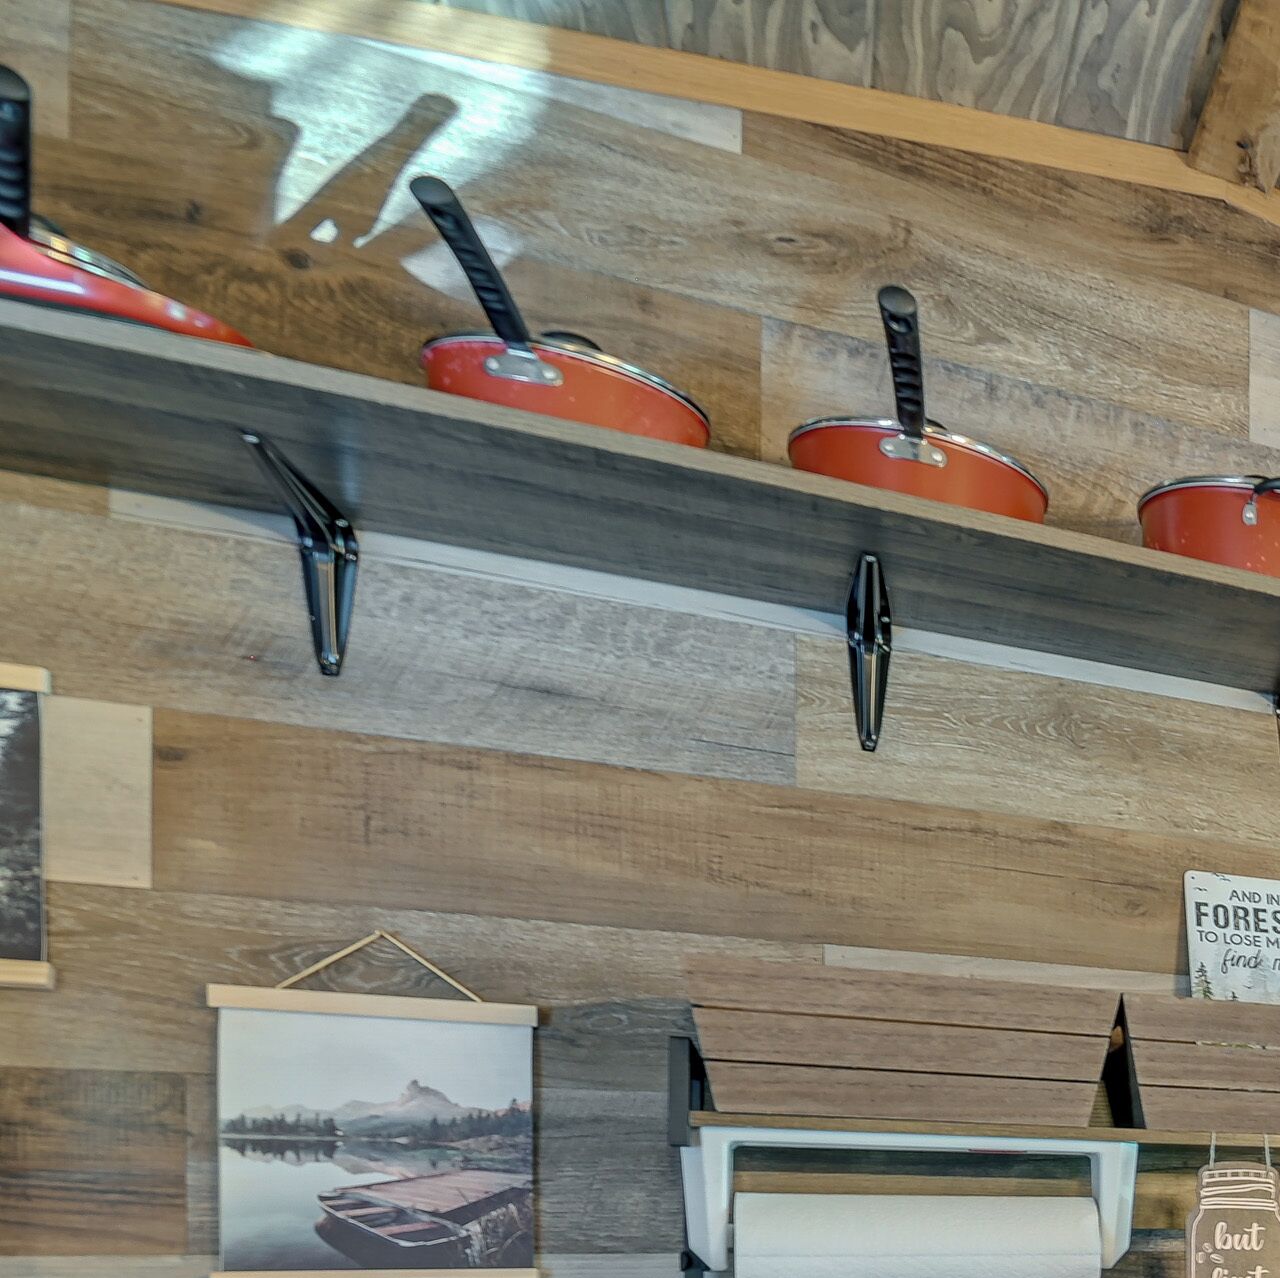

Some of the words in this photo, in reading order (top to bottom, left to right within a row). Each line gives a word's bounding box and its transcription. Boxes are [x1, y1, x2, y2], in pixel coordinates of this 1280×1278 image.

[1229, 889, 1262, 905] AND
[1196, 930, 1218, 943] TO
[1223, 932, 1261, 947] LOSE
[1220, 948, 1263, 974] find
[1214, 1221, 1267, 1251] but
